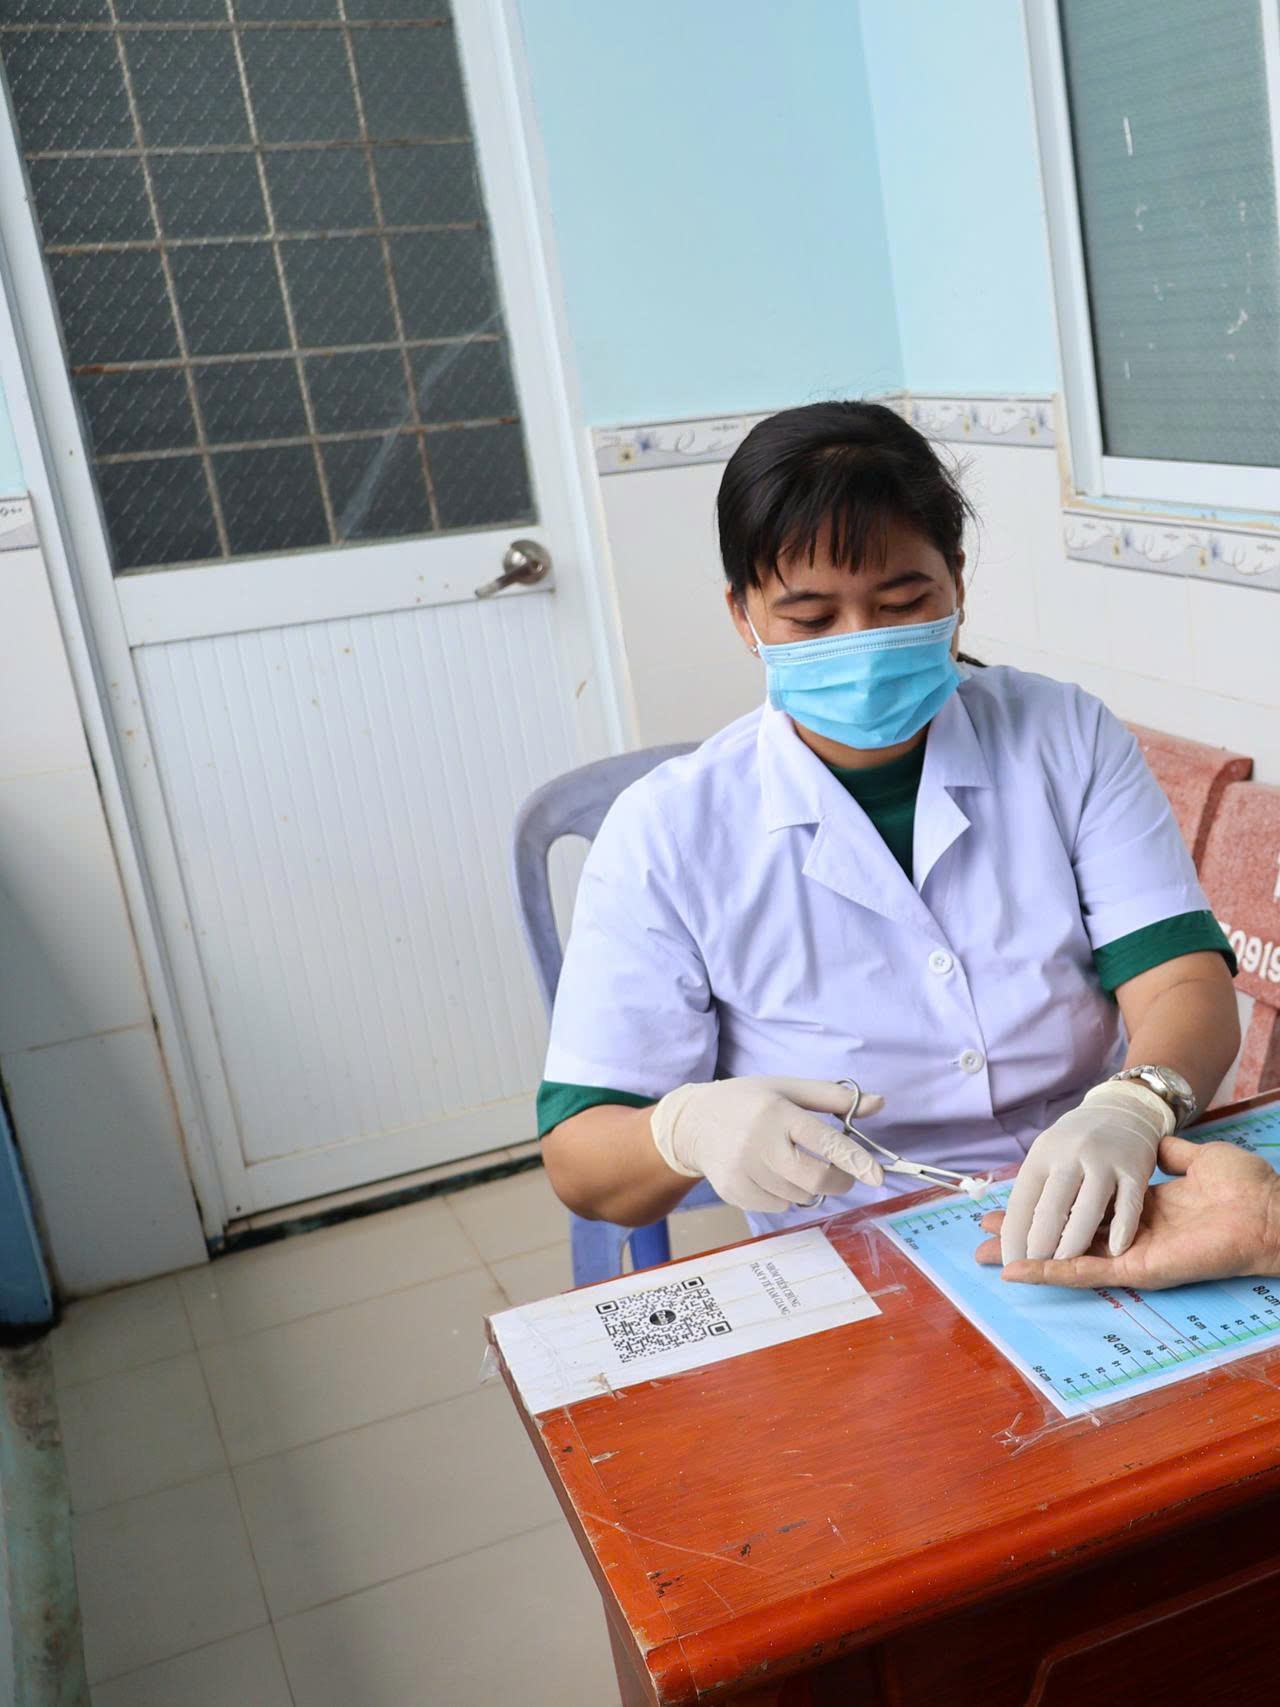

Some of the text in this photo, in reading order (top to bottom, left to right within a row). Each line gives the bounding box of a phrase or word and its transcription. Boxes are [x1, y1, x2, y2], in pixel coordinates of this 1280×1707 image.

[1252, 1285, 1271, 1296] 80
[1103, 1333, 1132, 1356] 90 cm
